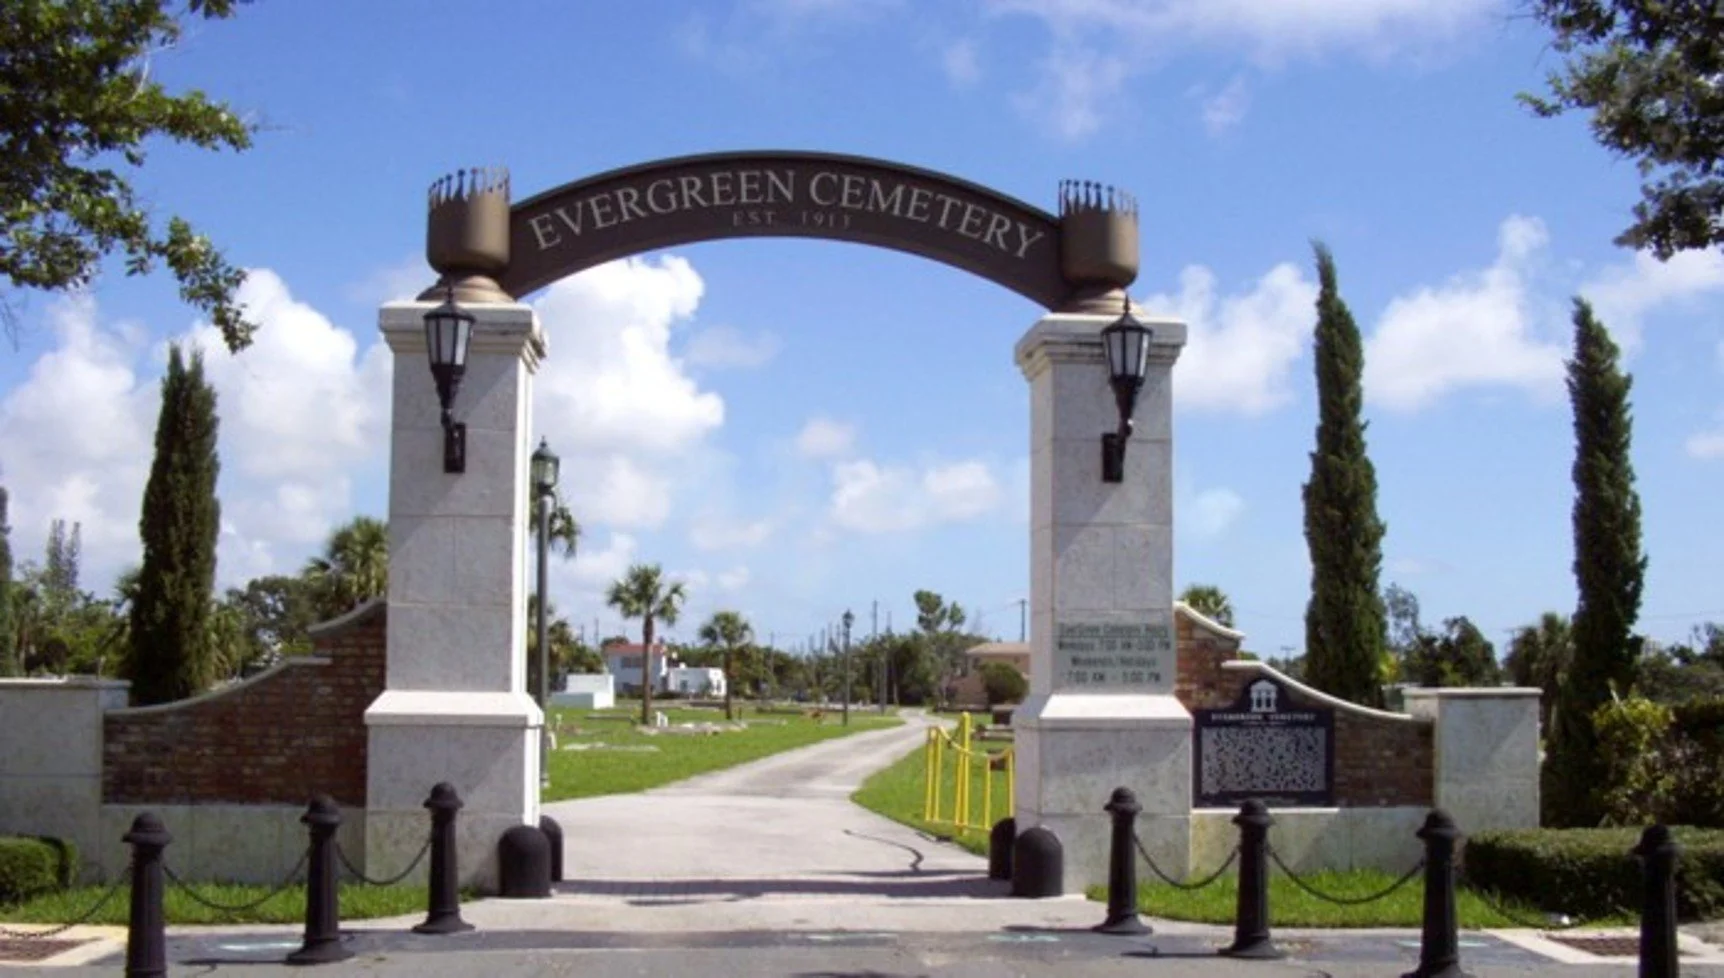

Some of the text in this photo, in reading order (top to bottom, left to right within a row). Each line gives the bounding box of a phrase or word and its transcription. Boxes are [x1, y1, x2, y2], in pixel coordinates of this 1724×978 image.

[527, 169, 1046, 260] EVERGREEN CEMETERY
[733, 210, 777, 227] EST
